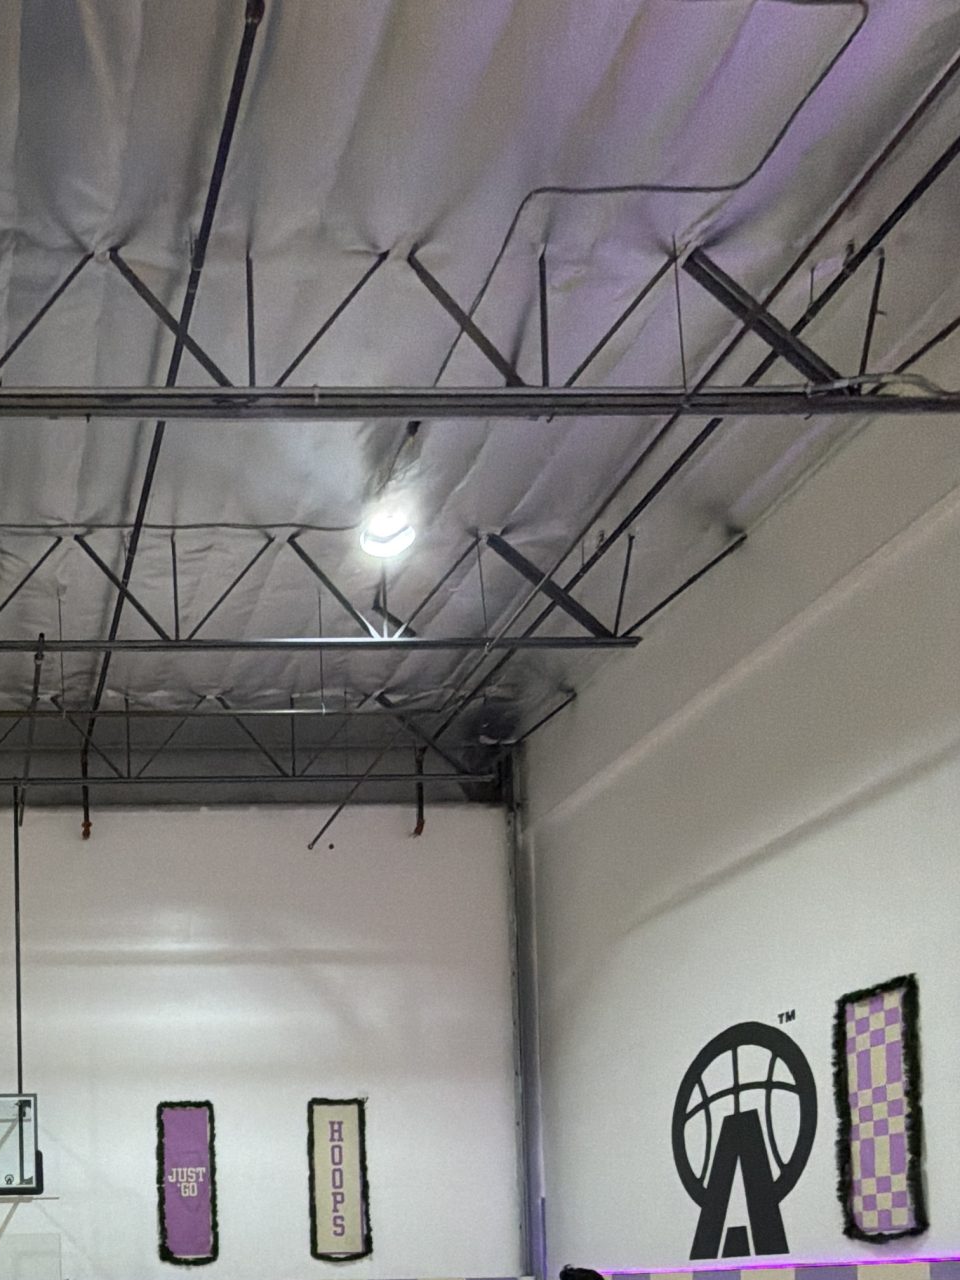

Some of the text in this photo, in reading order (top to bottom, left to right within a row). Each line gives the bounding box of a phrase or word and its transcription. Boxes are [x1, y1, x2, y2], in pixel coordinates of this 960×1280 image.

[777, 1009, 796, 1025] TM
[167, 1167, 206, 1183] JUST
[329, 1121, 346, 1236] HOOPS
